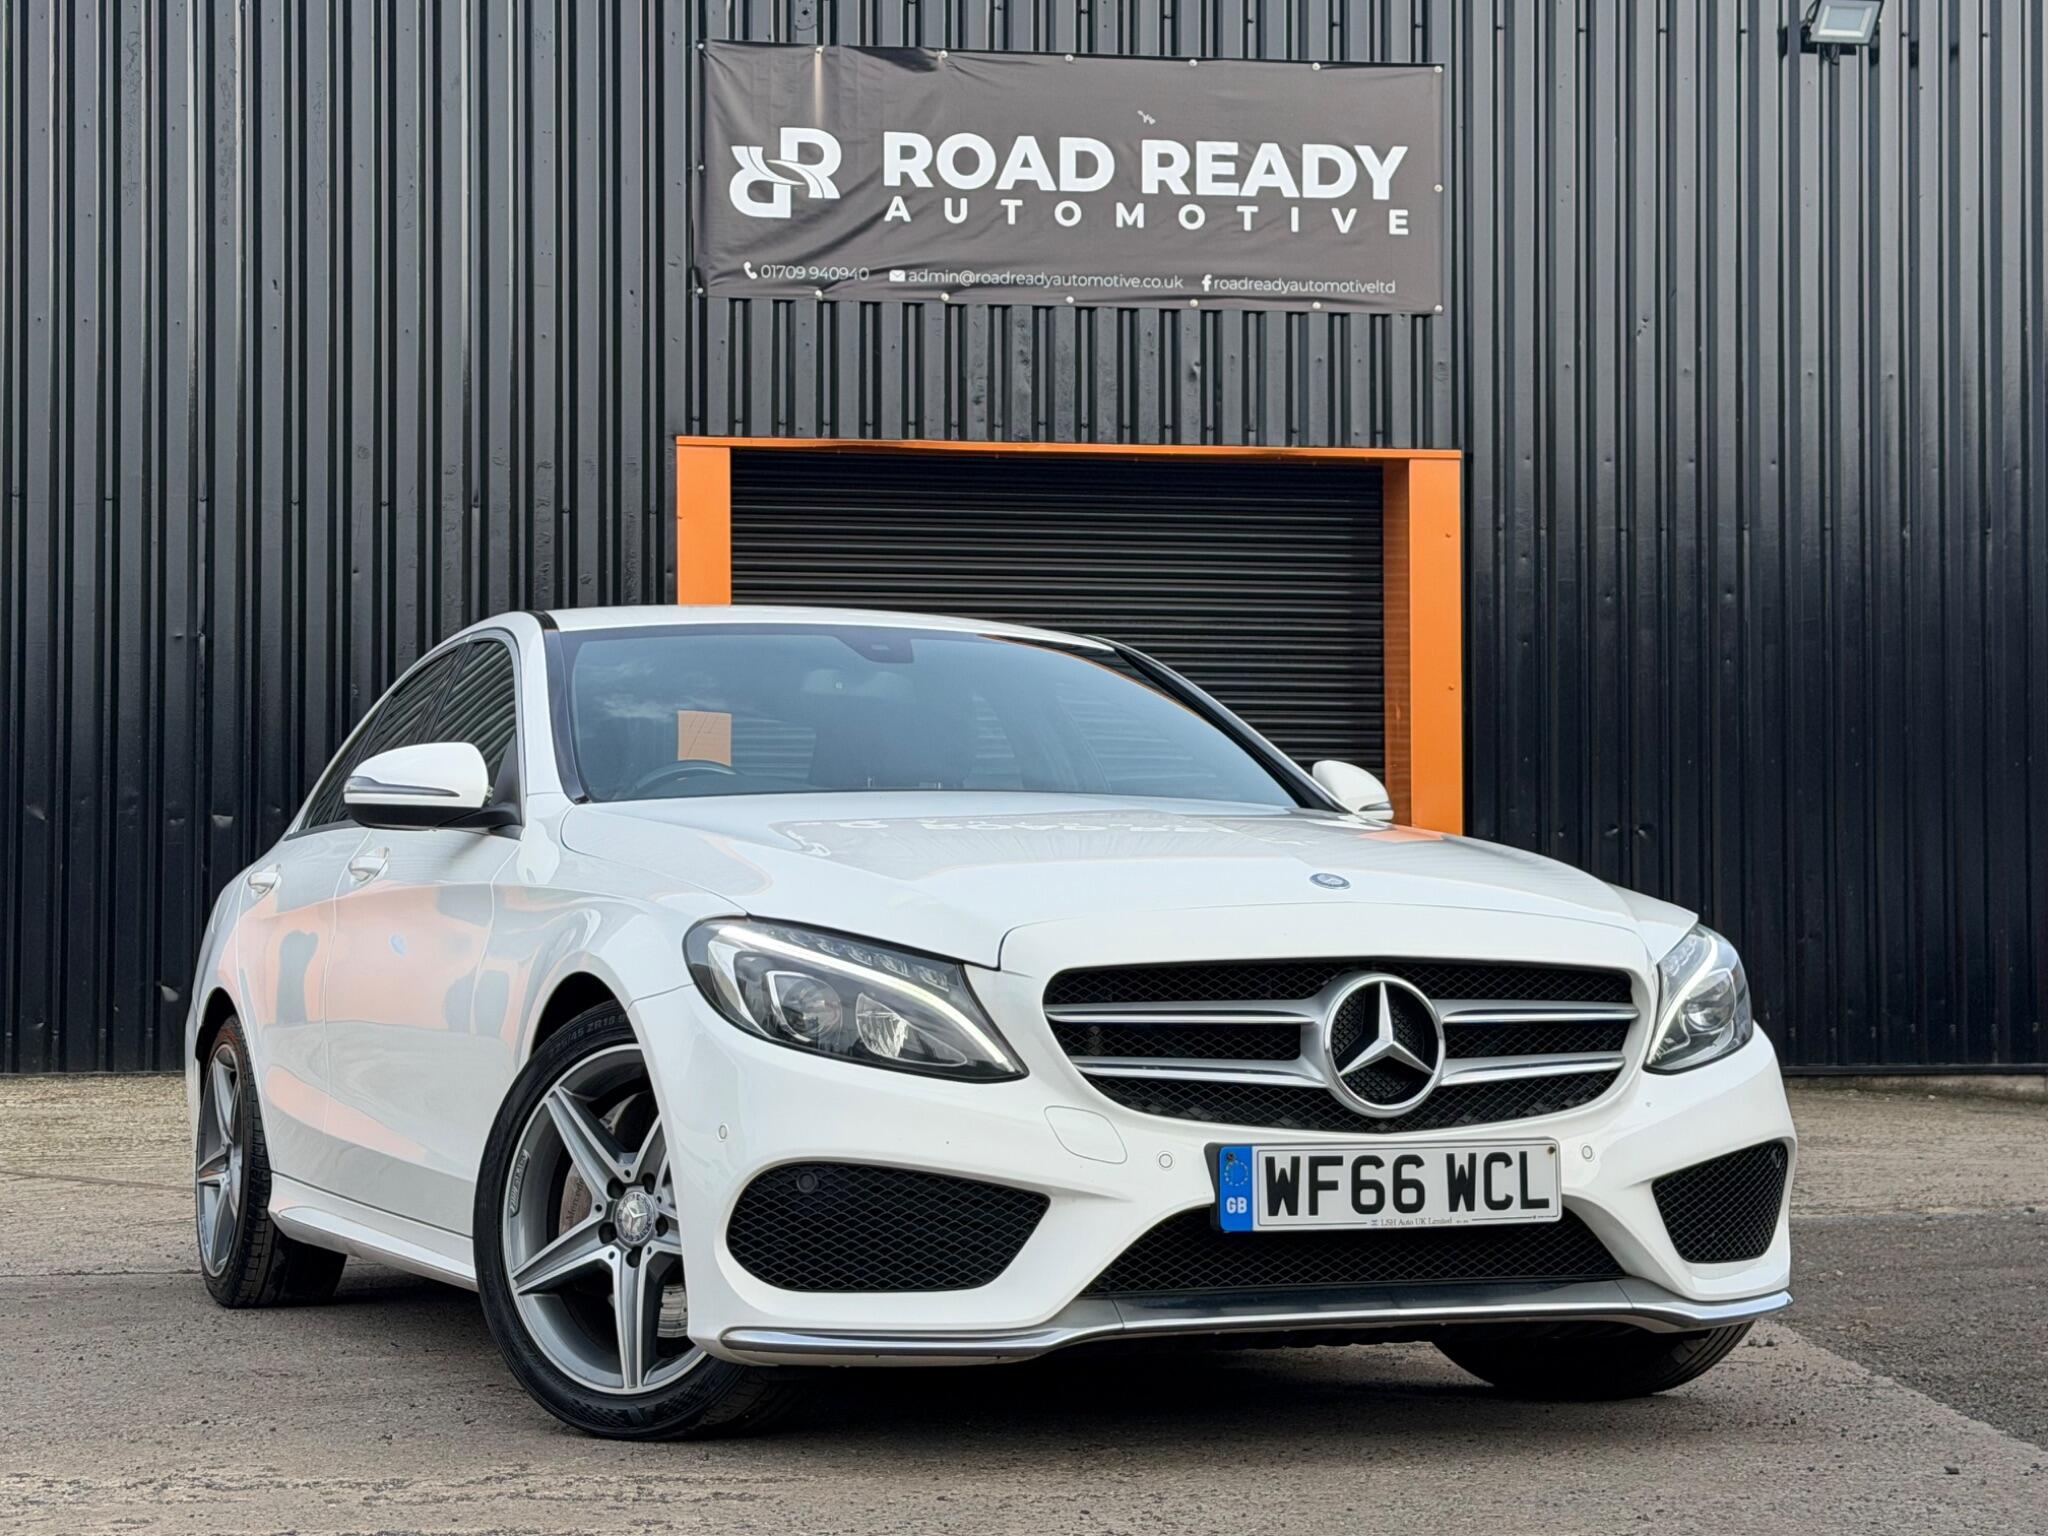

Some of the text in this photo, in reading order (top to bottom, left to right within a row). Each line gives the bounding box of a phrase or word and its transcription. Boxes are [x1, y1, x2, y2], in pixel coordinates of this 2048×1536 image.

[883, 131, 1409, 201] ROAD READY
[885, 195, 1410, 236] AUTOMOTIVE
[760, 264, 870, 281] 01709 940940
[908, 268, 1184, 289] admin@roadreadyautomotive.co.uk
[1214, 276, 1396, 294] roadreadyautomotiveltd
[1264, 1151, 1550, 1217] WF66 WCL
[1226, 1196, 1248, 1214] GB
